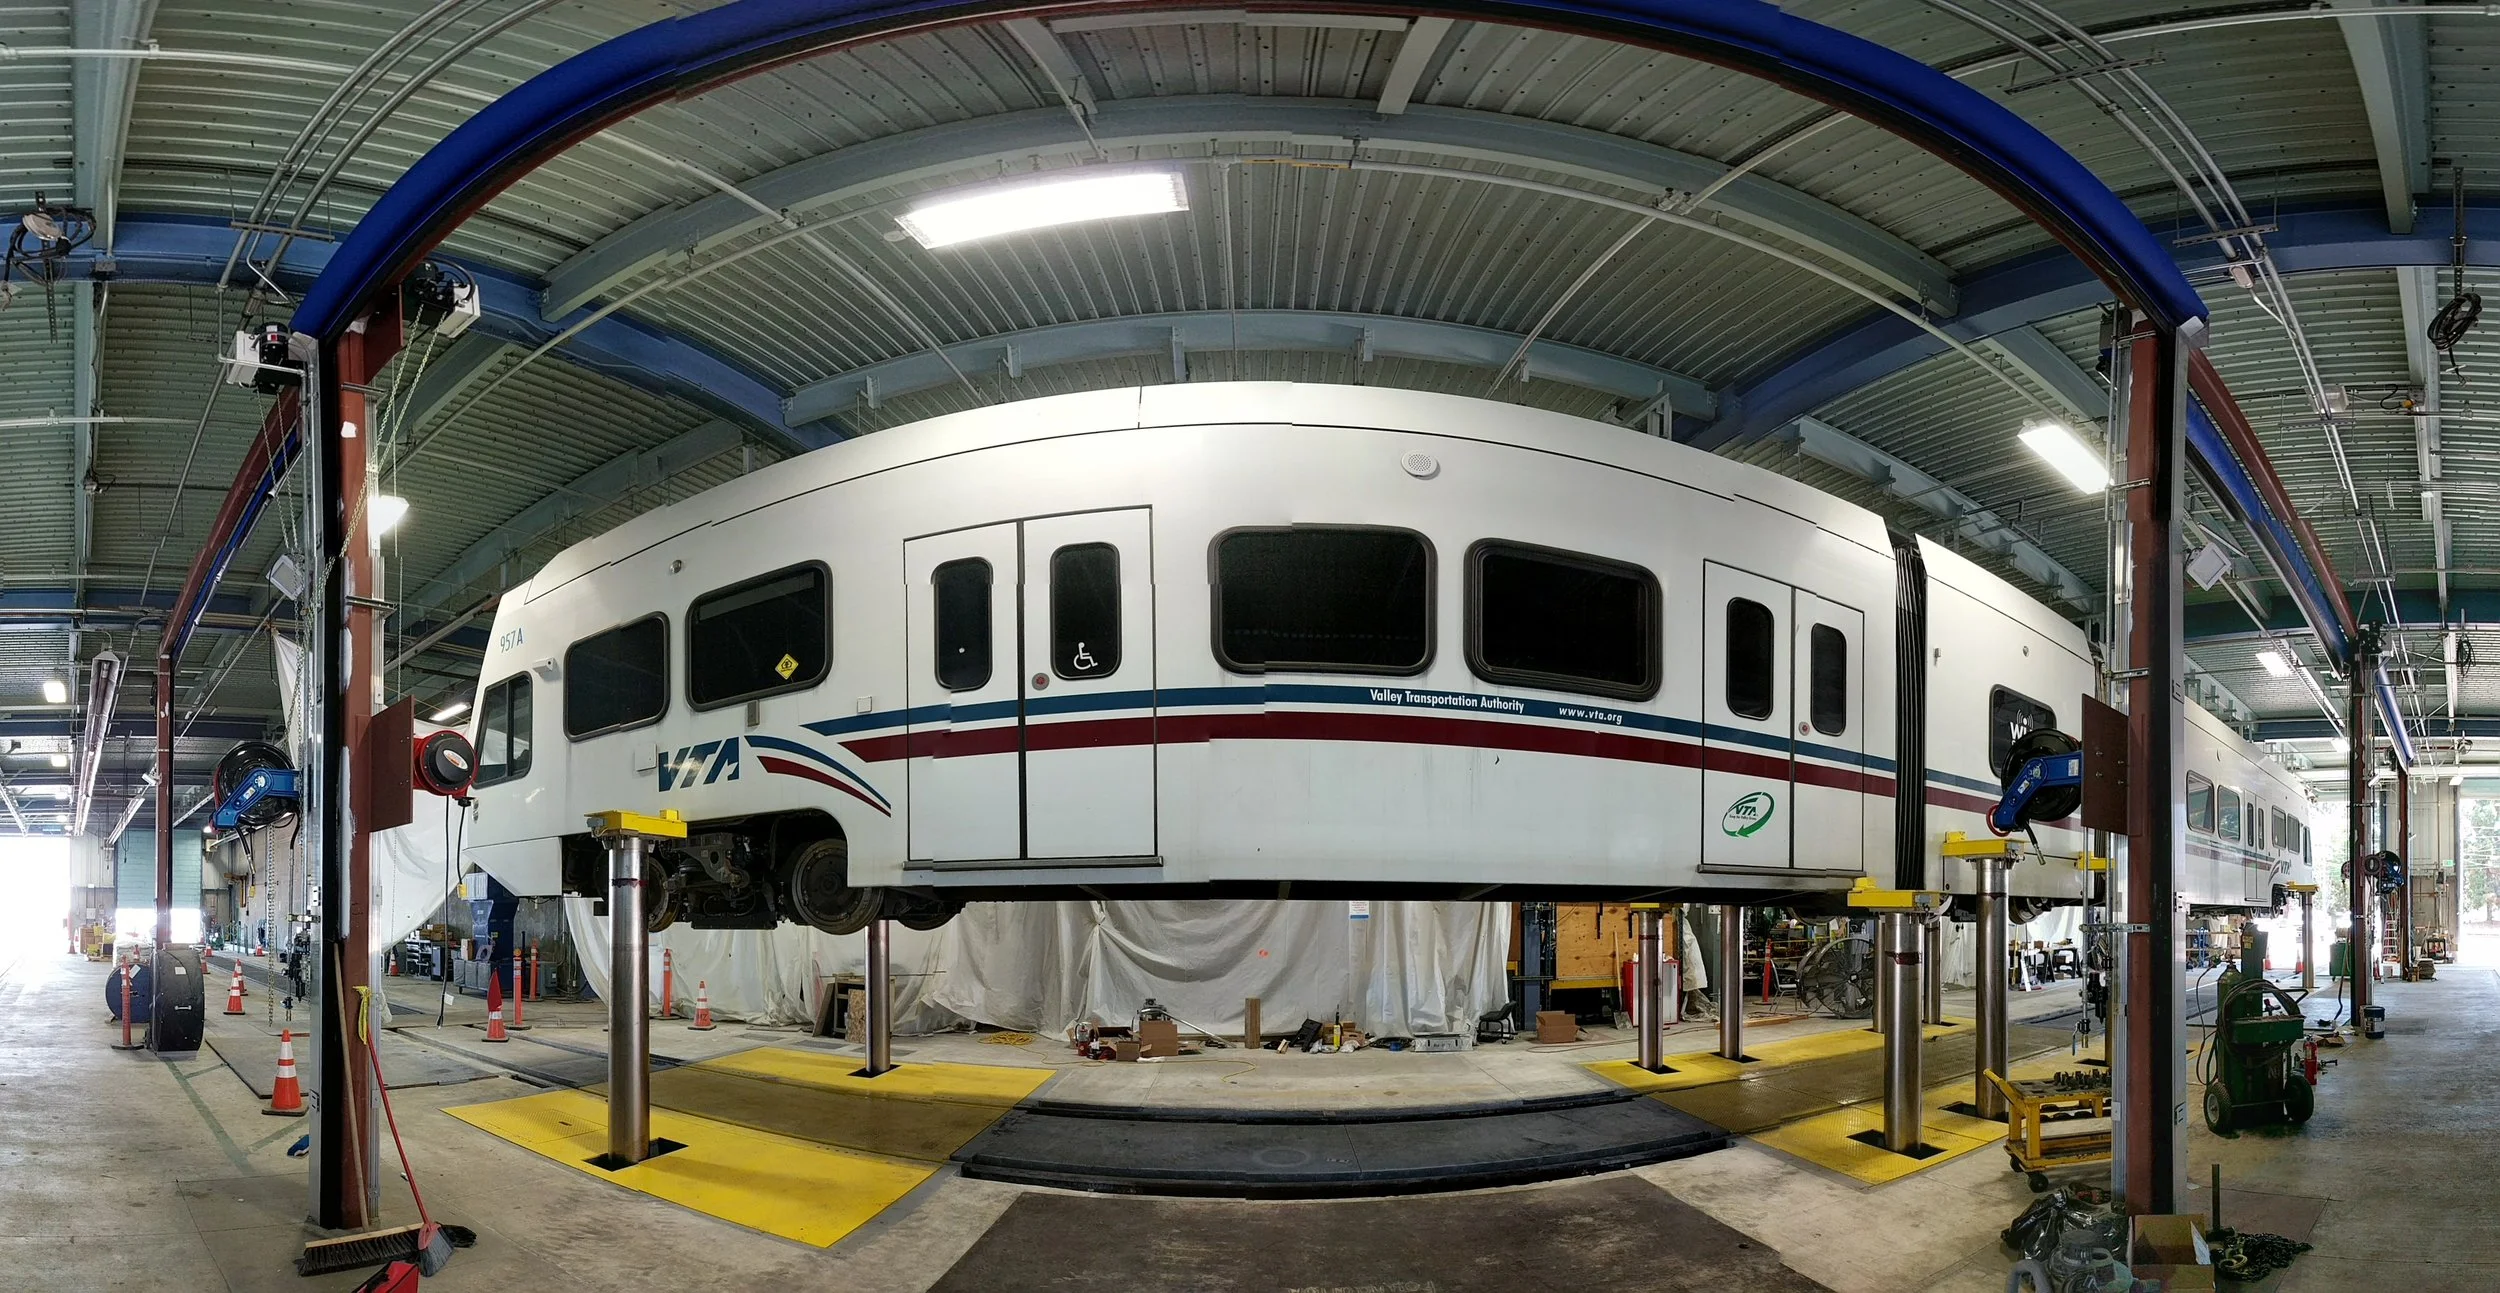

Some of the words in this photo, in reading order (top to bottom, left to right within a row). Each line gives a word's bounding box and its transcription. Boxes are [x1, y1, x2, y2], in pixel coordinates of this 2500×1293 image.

[500, 627, 524, 654] 957A
[1370, 689, 1403, 704] Valley
[1405, 691, 1478, 709] Transportation
[1480, 697, 1525, 714] Authority
[1558, 705, 1623, 726] www.vta.org
[658, 736, 740, 793] VTA
[1735, 804, 1757, 817] VTA
